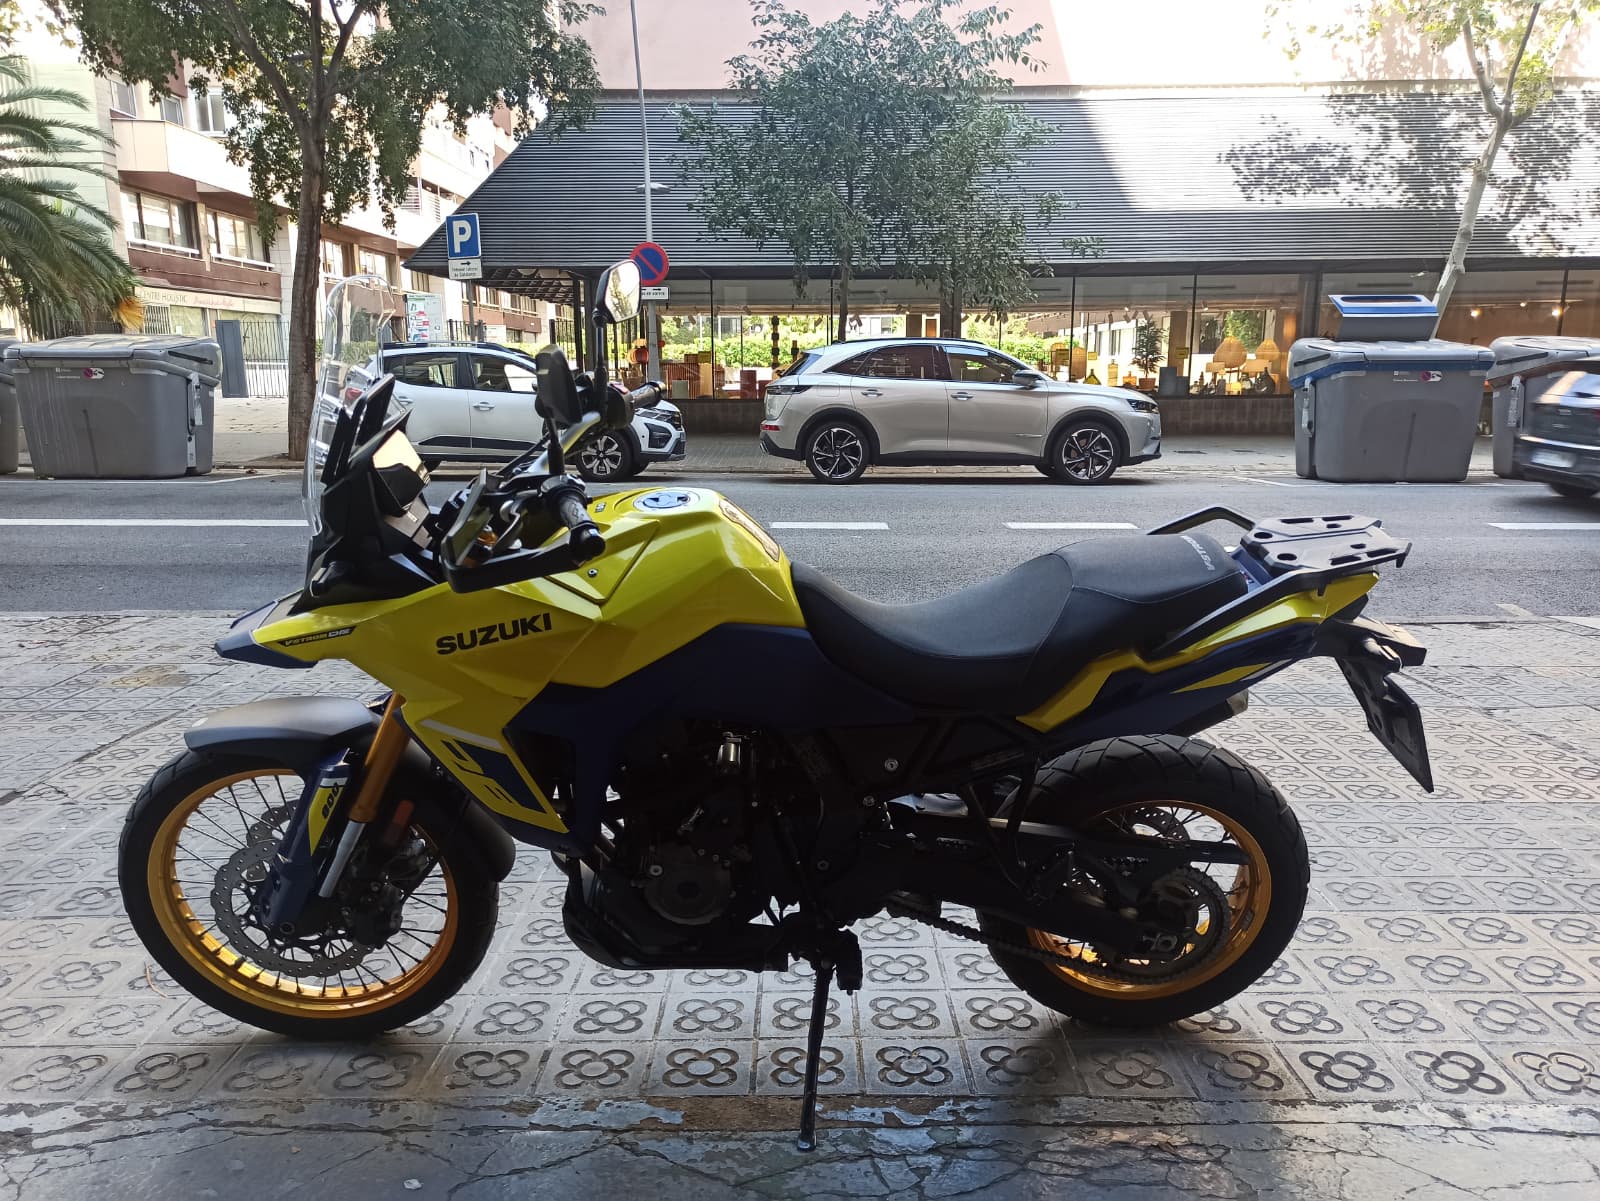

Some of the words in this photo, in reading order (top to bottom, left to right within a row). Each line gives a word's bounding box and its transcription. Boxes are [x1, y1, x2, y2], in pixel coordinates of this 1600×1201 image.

[452, 220, 471, 254] P
[436, 612, 552, 655] SUZUKI
[321, 782, 339, 819] 800
